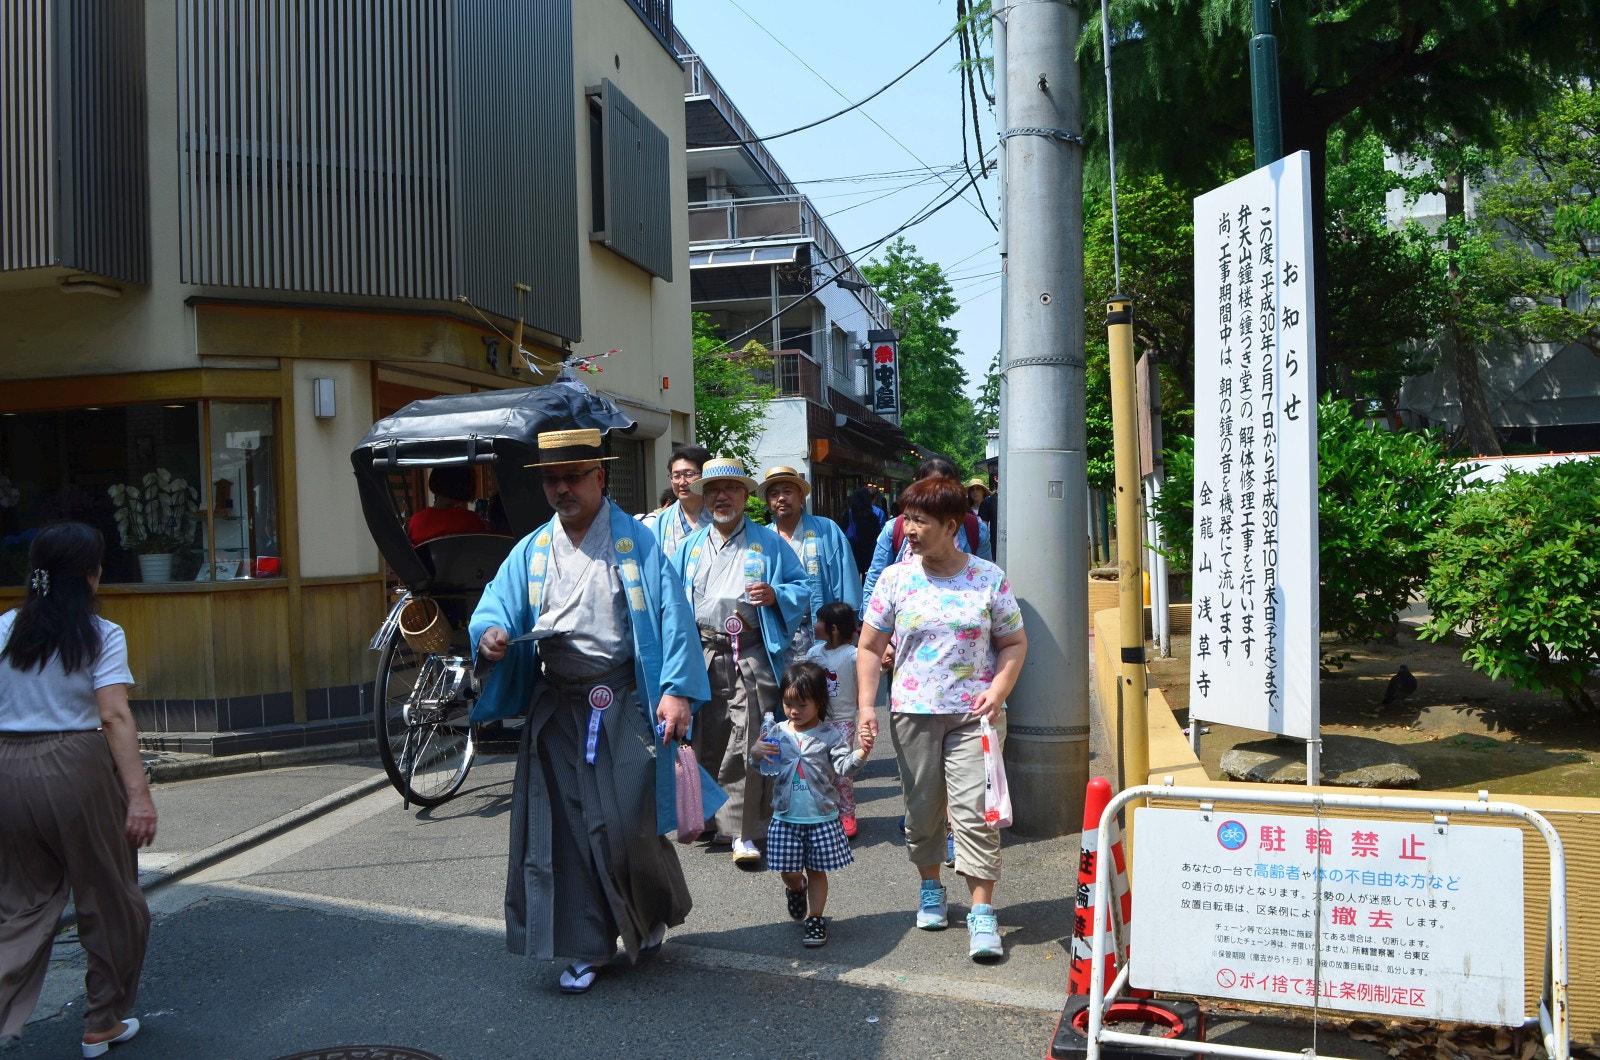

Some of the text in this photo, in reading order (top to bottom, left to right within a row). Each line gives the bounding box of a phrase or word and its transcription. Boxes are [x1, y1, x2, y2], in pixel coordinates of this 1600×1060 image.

[1282, 260, 1302, 421] お知らせ
[1259, 825, 1427, 861] 駐輪禁止
[1182, 863, 1460, 891] あなたの一台で高齢者や体の不自由な方など
[1331, 906, 1394, 929] 撤去
[1406, 916, 1444, 929] します。
[1215, 923, 1430, 948] チェーン等で公共物に施錠てある場合は、切断します。
[1239, 972, 1426, 1007] ポイ捨て禁止条例制定区
